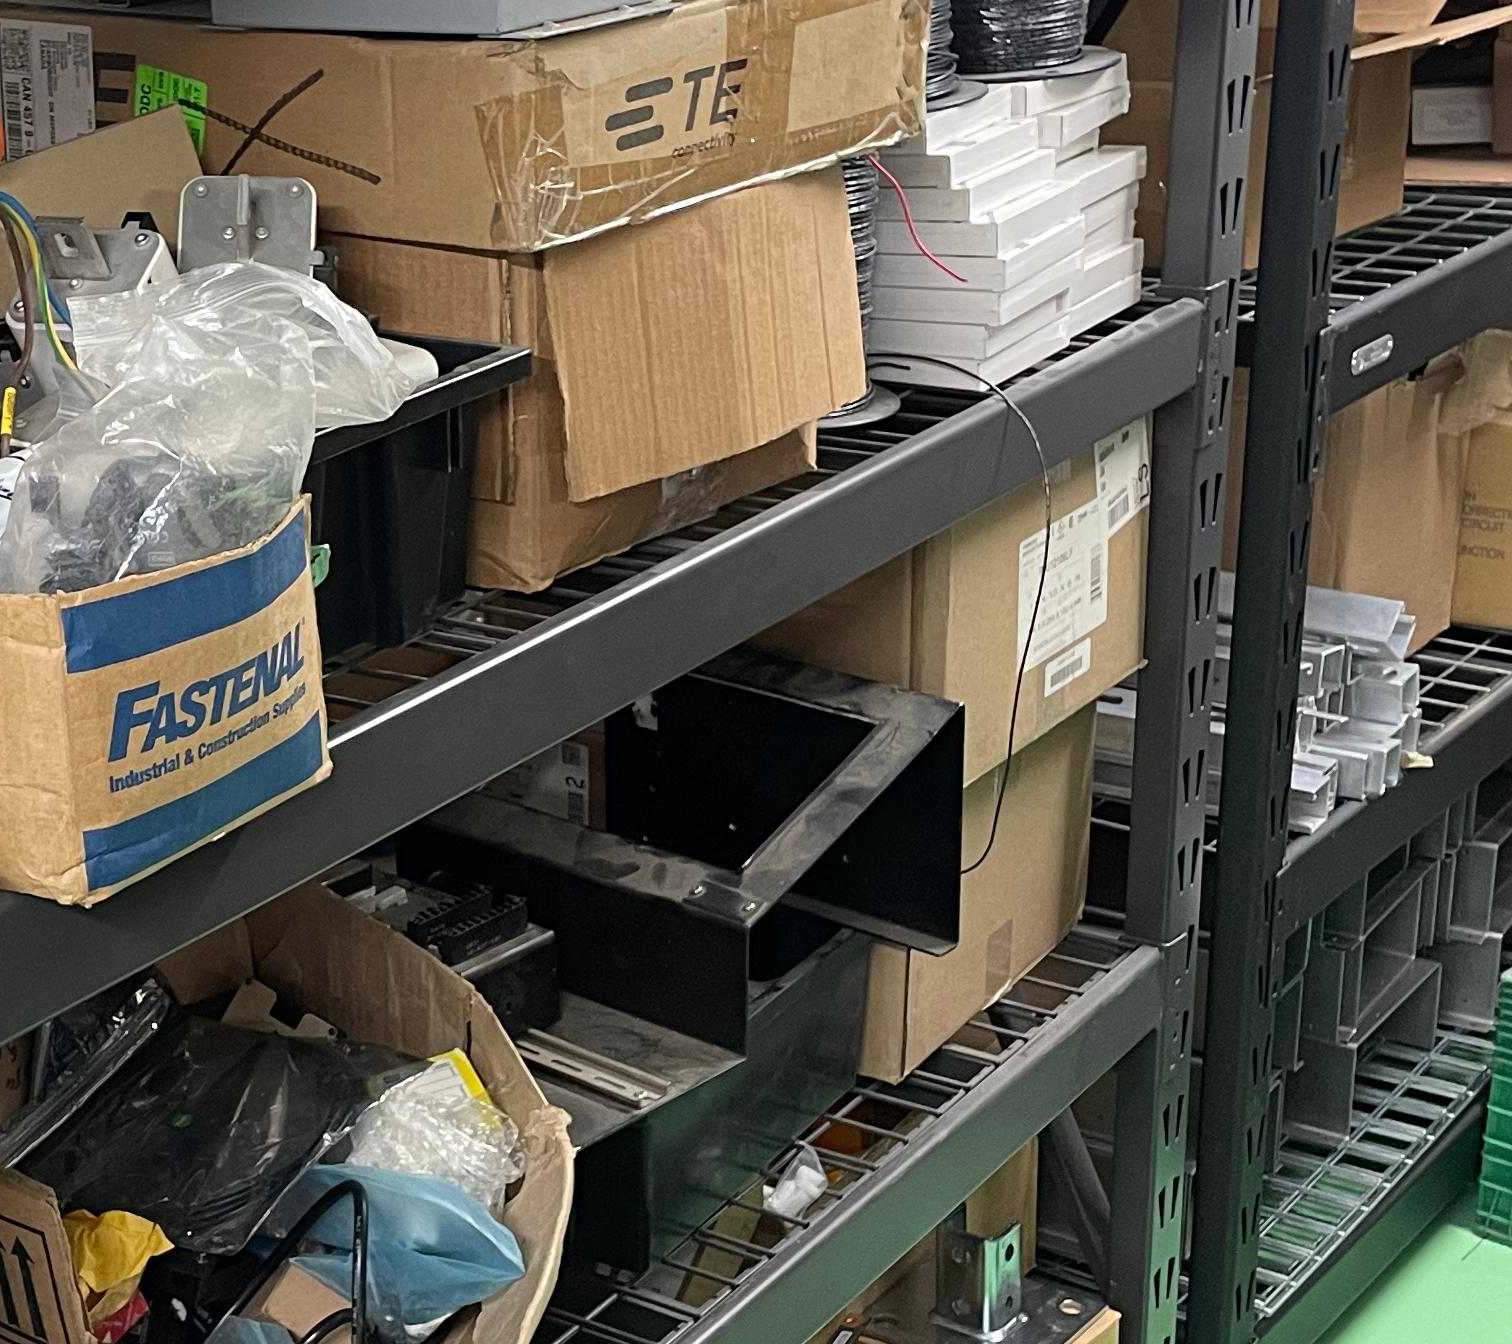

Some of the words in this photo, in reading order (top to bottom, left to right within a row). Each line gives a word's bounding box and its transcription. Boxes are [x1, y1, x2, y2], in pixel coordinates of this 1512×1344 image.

[683, 58, 748, 132] TE
[108, 622, 304, 763] FASTENAL
[109, 753, 181, 793] Industrial
[184, 748, 195, 766] &
[198, 711, 270, 760] Construction
